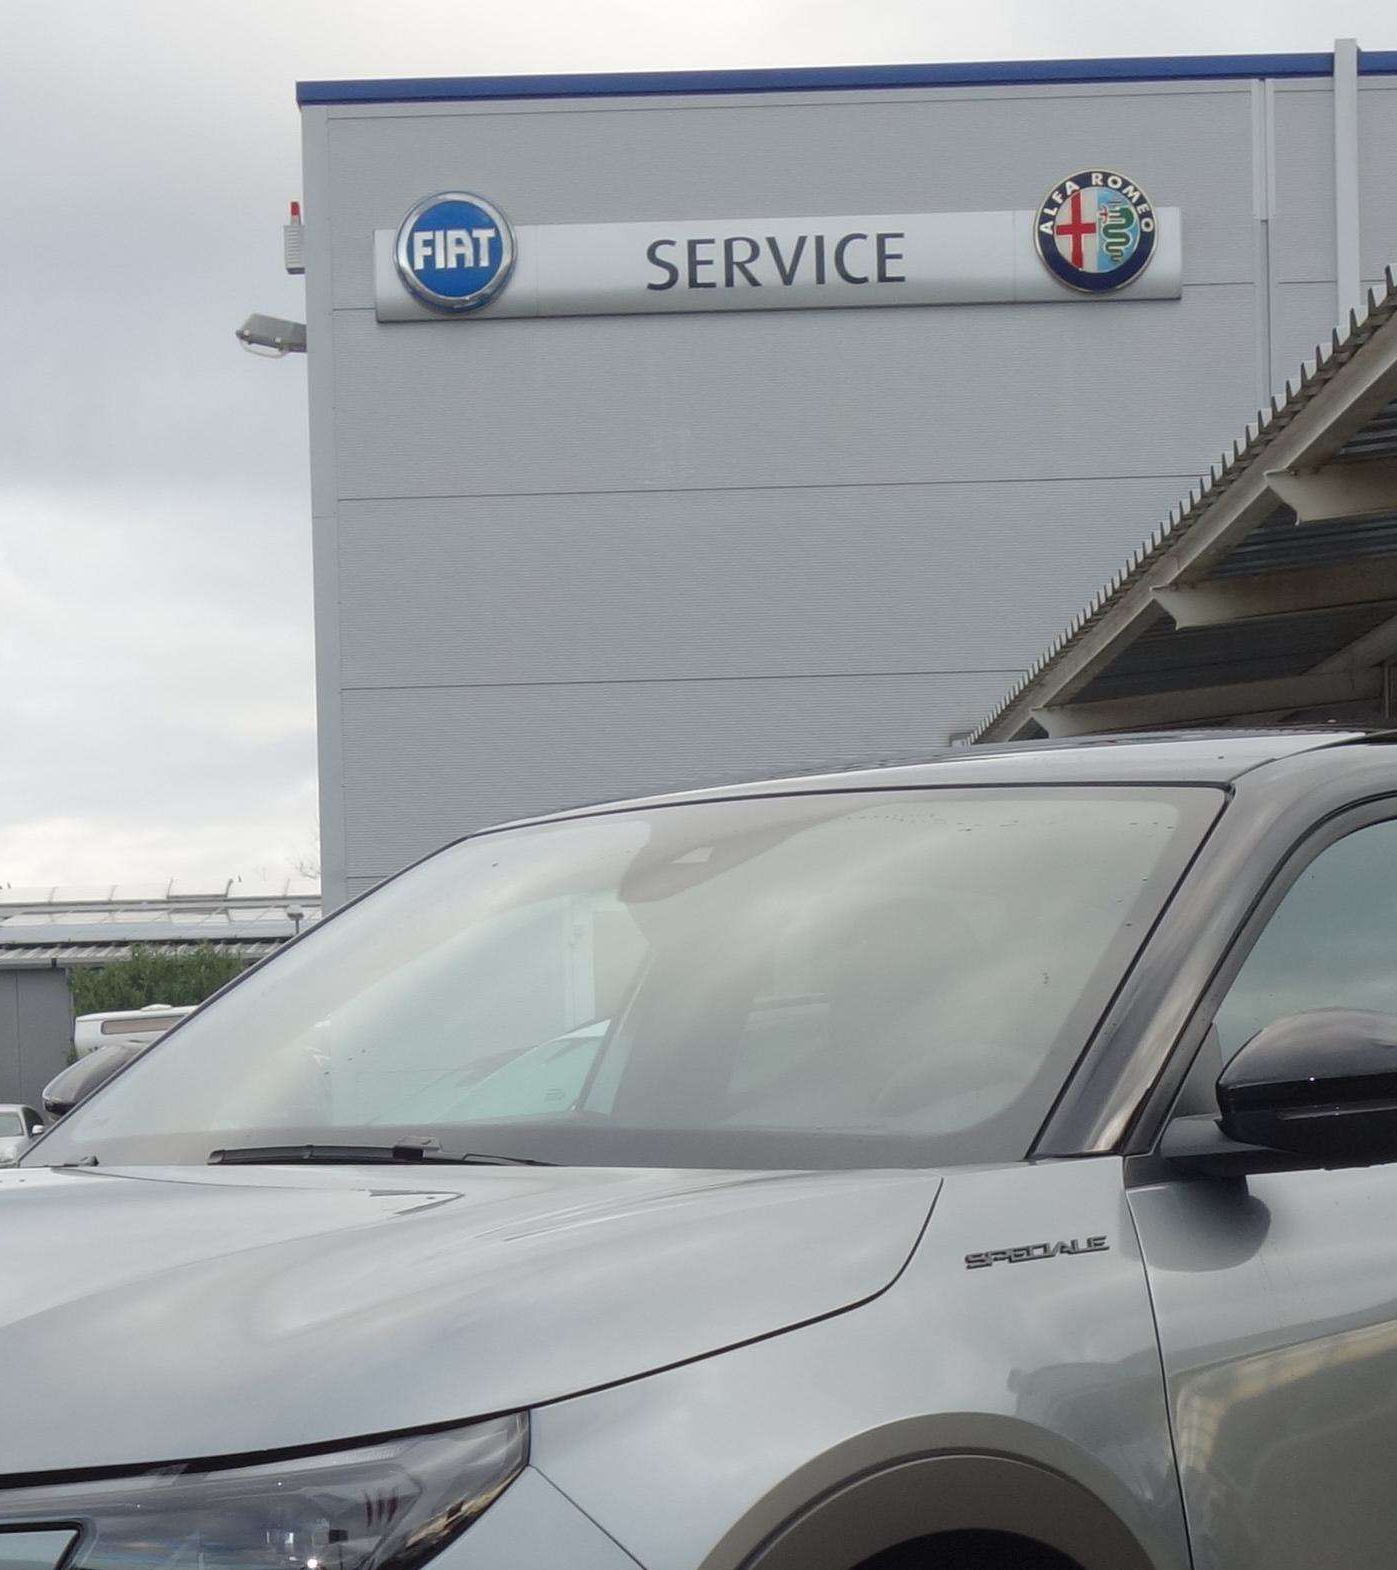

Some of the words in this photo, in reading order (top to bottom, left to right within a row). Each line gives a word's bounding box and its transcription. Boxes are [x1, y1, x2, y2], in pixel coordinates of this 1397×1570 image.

[1040, 181, 1080, 235] ALFA
[1091, 172, 1154, 232] ROMEO
[413, 228, 495, 271] FIAT
[646, 232, 906, 291] SERVICE
[965, 1235, 1110, 1270] SPECIALE
